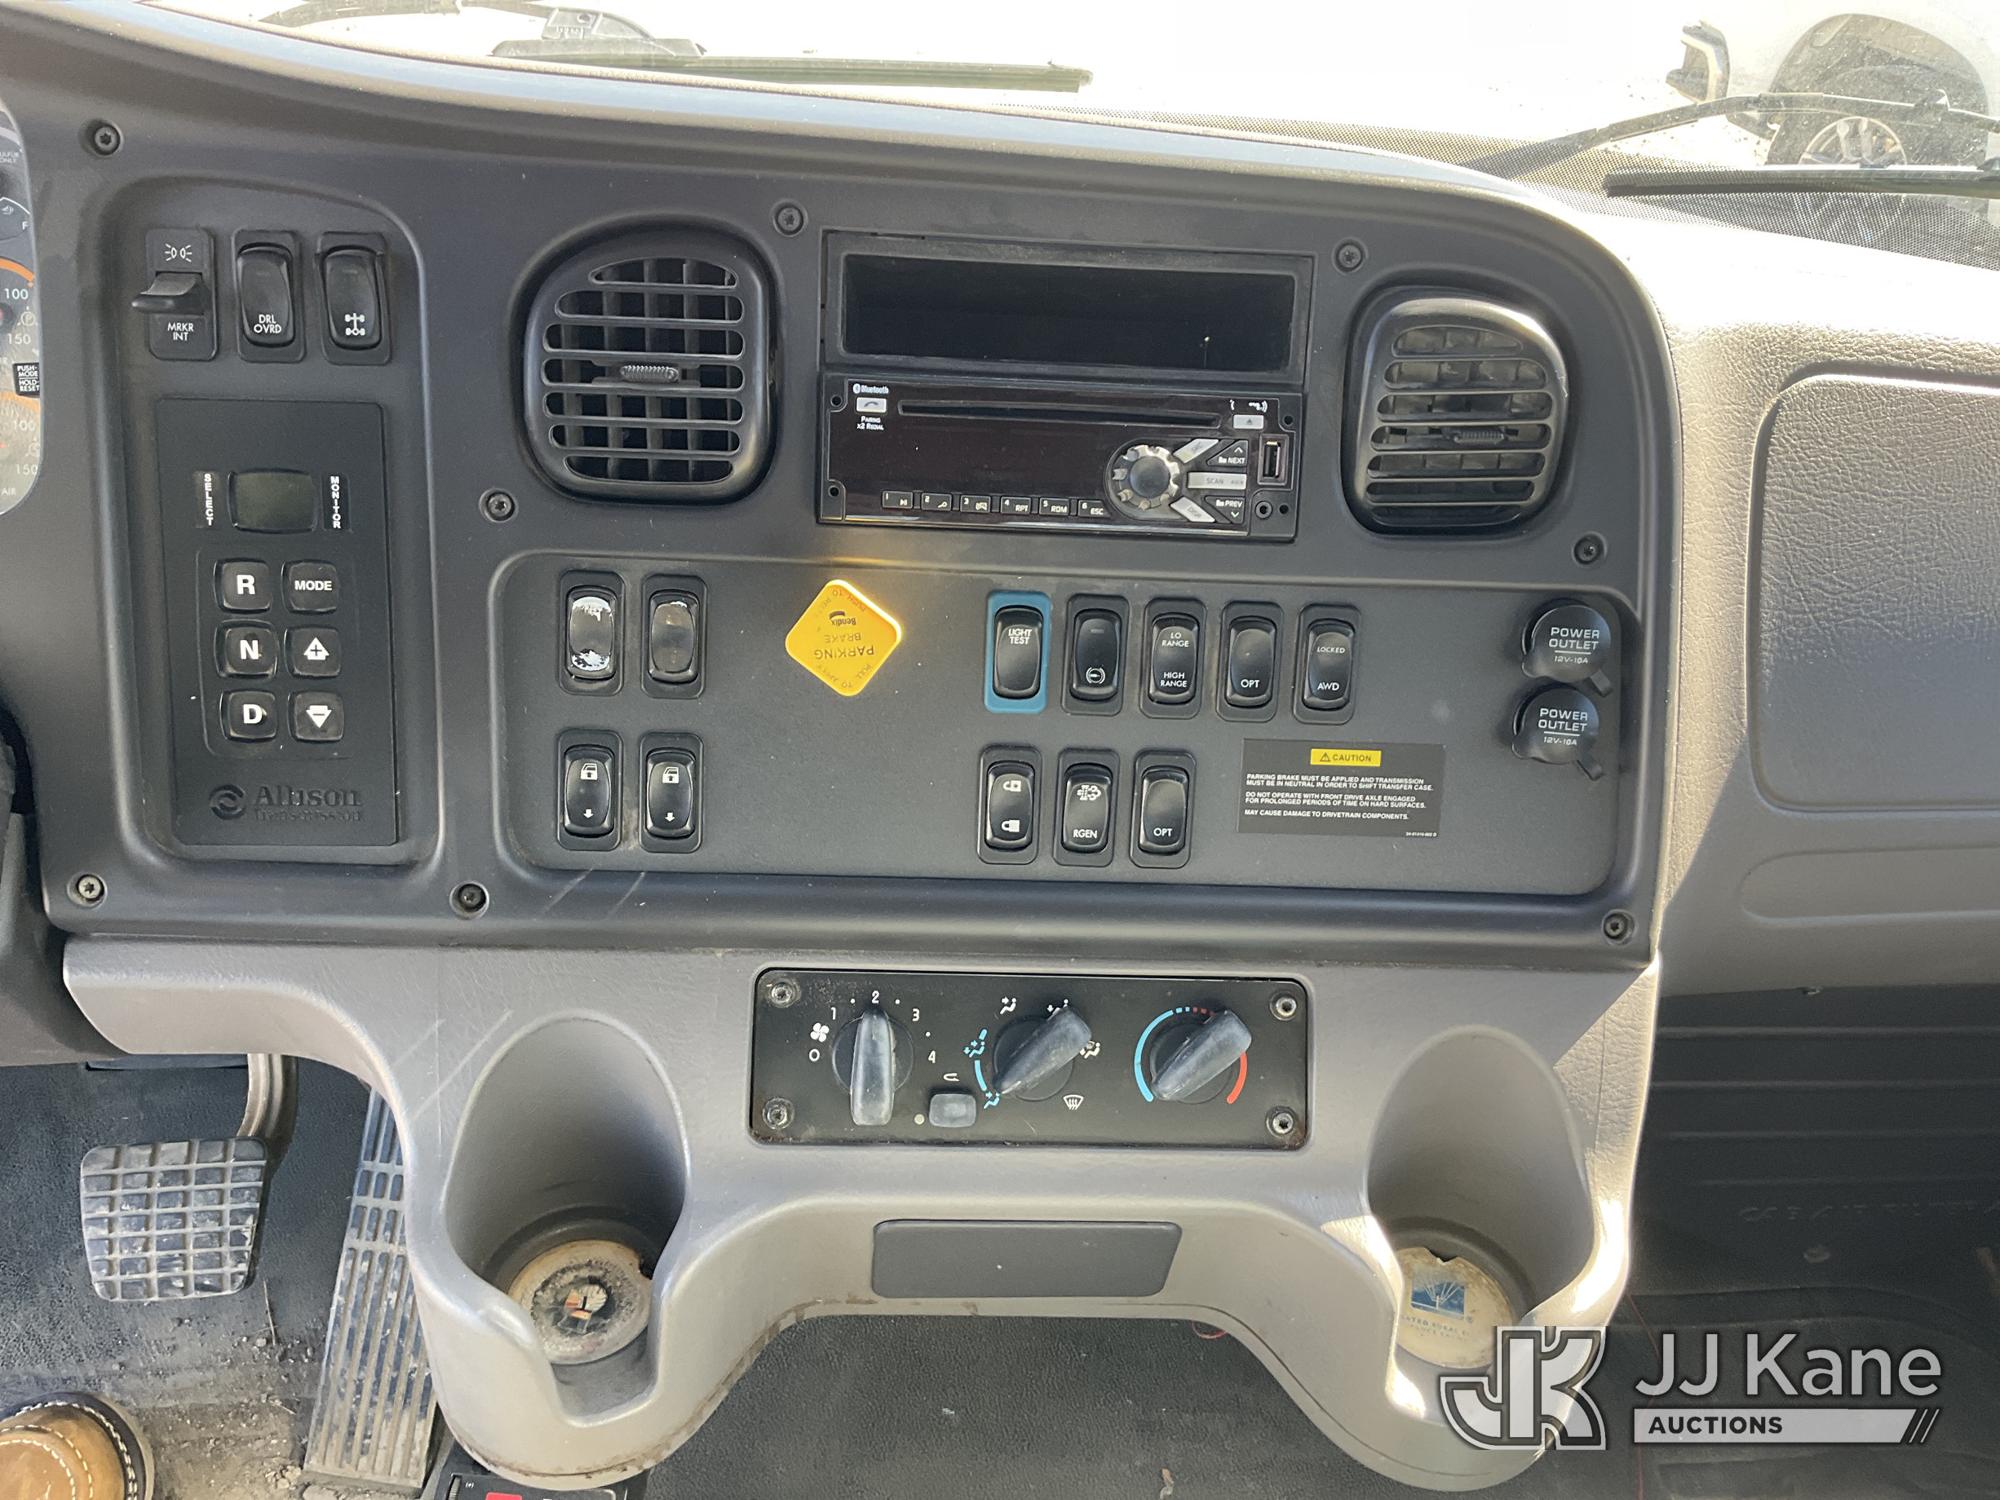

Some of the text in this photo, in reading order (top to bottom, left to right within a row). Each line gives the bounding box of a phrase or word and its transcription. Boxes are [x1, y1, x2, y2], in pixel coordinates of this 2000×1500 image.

[4, 288, 29, 300] 100
[258, 314, 276, 324] DRL
[167, 322, 194, 332] MRKR
[253, 323, 282, 334] OVRD
[7, 333, 31, 345] 150
[172, 332, 189, 341] INT
[16, 464, 38, 475] 150
[204, 473, 214, 526] SELECT
[330, 476, 341, 529] MONITOR
[236, 575, 256, 594] R
[294, 580, 332, 591] MODE
[831, 617, 857, 626] Bendix
[824, 632, 861, 643] BRAKE
[1008, 628, 1032, 638] LIGHT
[1170, 632, 1182, 640] LO
[1550, 627, 1600, 639] POWER
[1009, 636, 1030, 645] TEST
[1161, 638, 1189, 648] RANGE
[1549, 638, 1599, 650] OUTLET
[239, 640, 259, 660] N
[814, 645, 874, 660] PARKING
[1317, 646, 1345, 654] LOCKED
[1163, 671, 1185, 680] HIGH
[1160, 678, 1187, 688] RANGE
[1240, 678, 1260, 689] OPT
[1317, 682, 1340, 691] AWD
[243, 704, 263, 724] D
[1539, 708, 1588, 721] POWER
[1538, 719, 1587, 732] OUTLET
[1332, 754, 1372, 762] CAUTION
[1073, 829, 1097, 839] RGEN
[1153, 828, 1173, 837] OPT
[871, 990, 880, 1004] 2
[830, 1007, 837, 1020] 1
[912, 1008, 920, 1022] 3
[928, 1050, 936, 1063] 4
